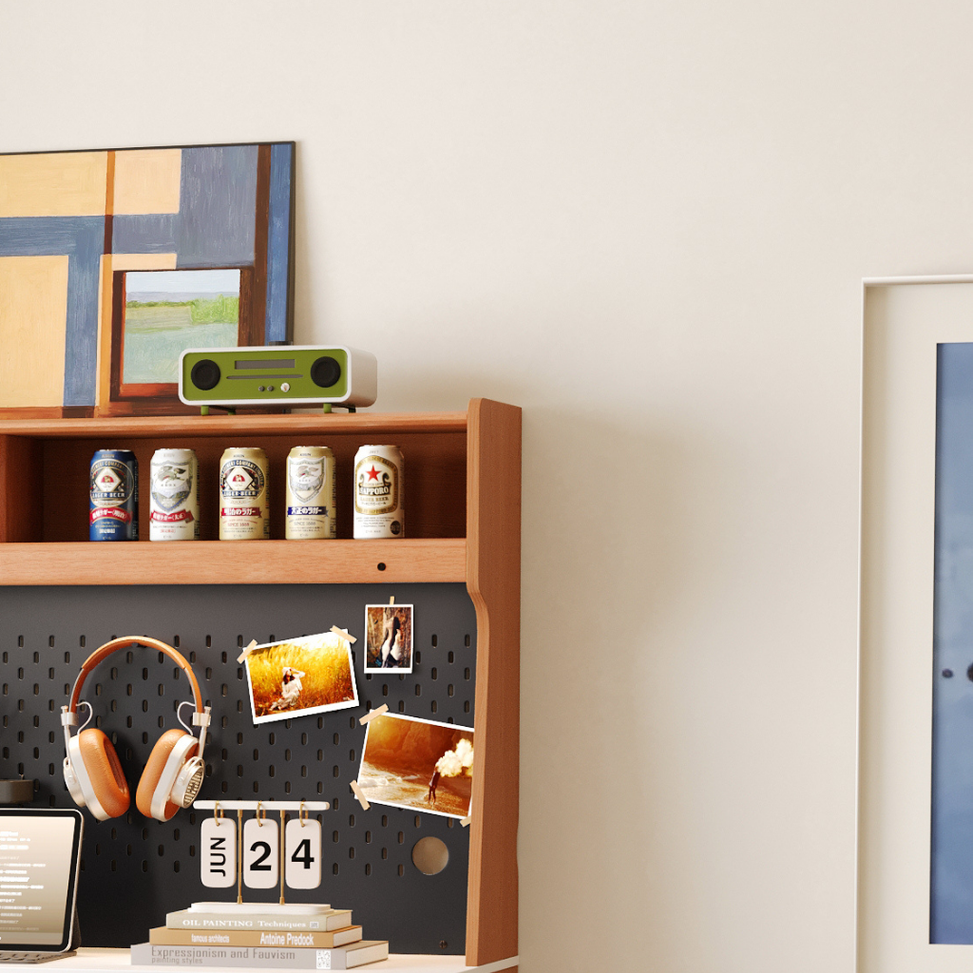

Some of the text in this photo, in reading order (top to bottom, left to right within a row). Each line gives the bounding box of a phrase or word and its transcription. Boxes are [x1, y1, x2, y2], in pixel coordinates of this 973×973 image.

[359, 486, 389, 495] SAPPORO
[210, 837, 226, 877] JUN
[249, 839, 315, 871] 2 4
[182, 919, 307, 929] OIL PAINTING Techniques
[191, 933, 230, 944] famous architects
[259, 932, 315, 946] Antoine Predock
[230, 948, 249, 959] and
[252, 948, 296, 960] Fauvism
[151, 956, 203, 965] painting styles
